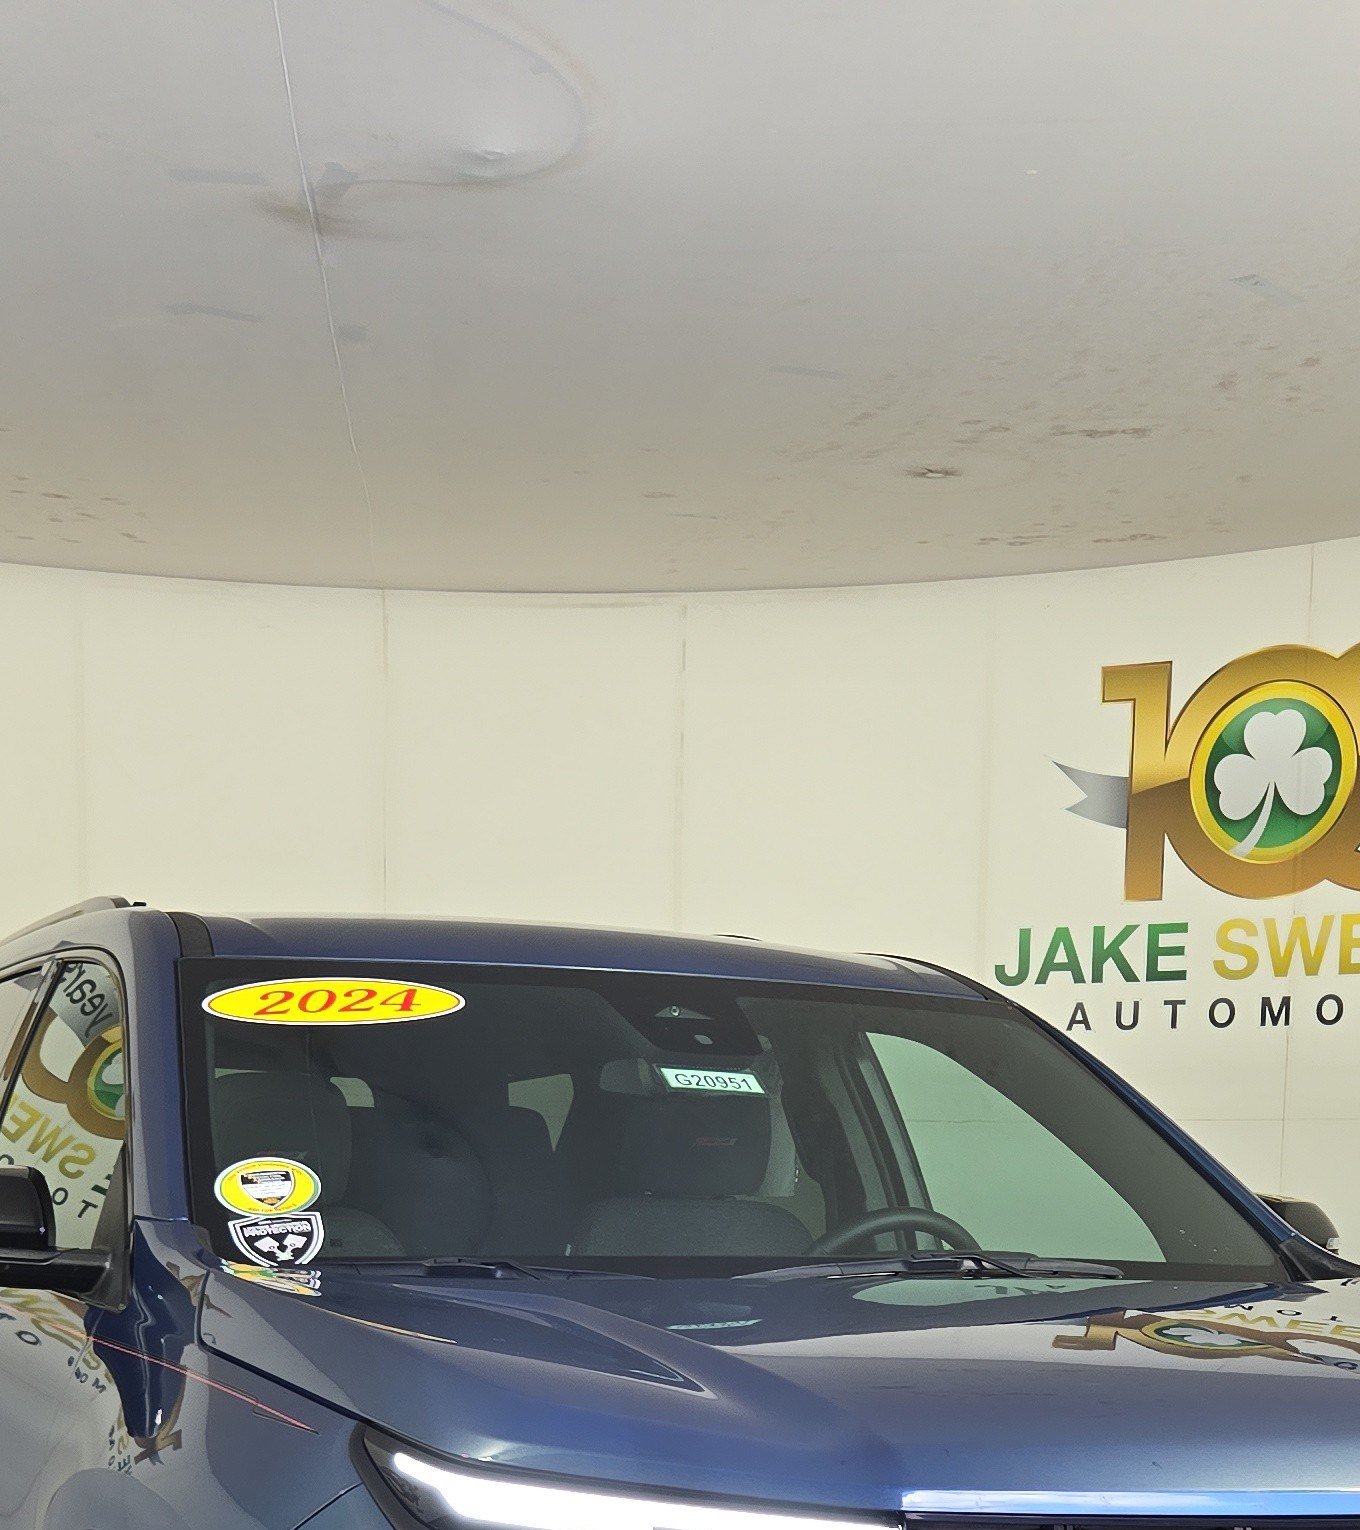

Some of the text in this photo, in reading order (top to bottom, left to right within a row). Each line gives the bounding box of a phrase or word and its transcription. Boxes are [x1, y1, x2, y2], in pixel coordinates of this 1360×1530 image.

[995, 922, 1188, 986] JAKE
[253, 988, 421, 1016] 2024
[674, 1073, 752, 1091] G20951
